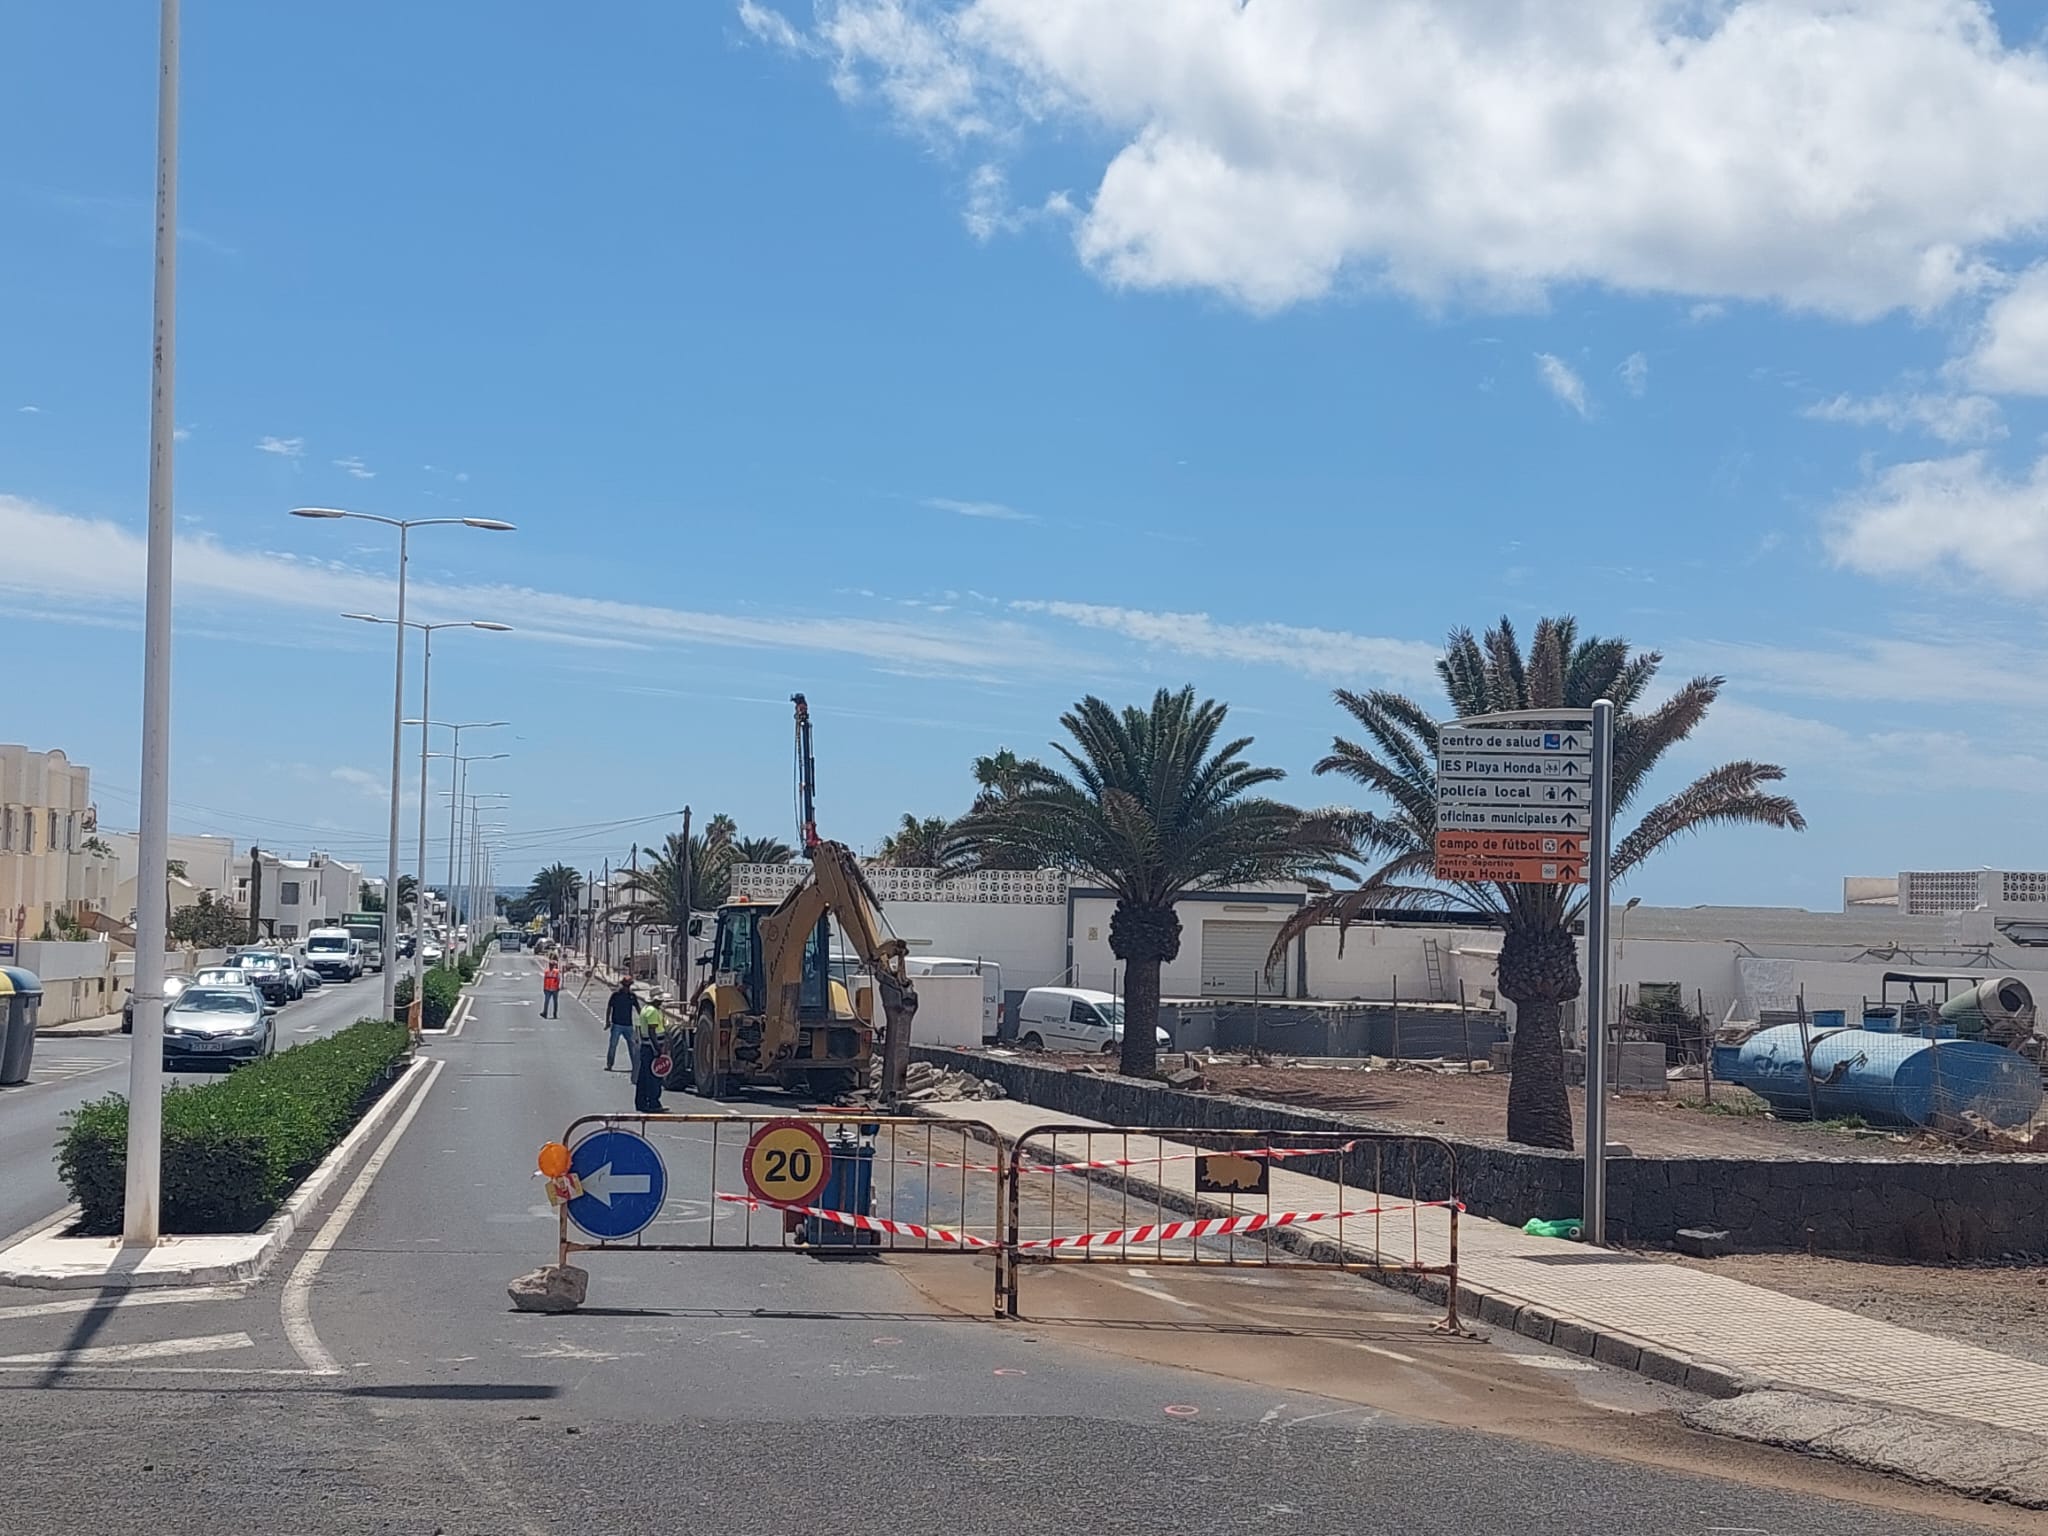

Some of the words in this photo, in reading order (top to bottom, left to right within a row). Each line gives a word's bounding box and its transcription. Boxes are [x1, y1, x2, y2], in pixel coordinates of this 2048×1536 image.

[1441, 735, 1483, 747] centro
[1487, 735, 1501, 747] de
[1506, 735, 1541, 748] salud
[1440, 760, 1462, 772] IES
[1465, 761, 1499, 775] Playa
[1503, 762, 1542, 774] Honda
[1440, 785, 1487, 799] policía
[1495, 786, 1531, 798] local
[1440, 810, 1486, 823] oficinas
[1491, 811, 1558, 826] municipales
[1439, 839, 1478, 852] campo
[1482, 838, 1498, 849] de
[1502, 838, 1540, 851] fútbol
[1472, 859, 1515, 868] deportivo
[1438, 868, 1475, 880] Playa
[1479, 868, 1521, 880] Honda
[765, 1148, 811, 1182] 20
